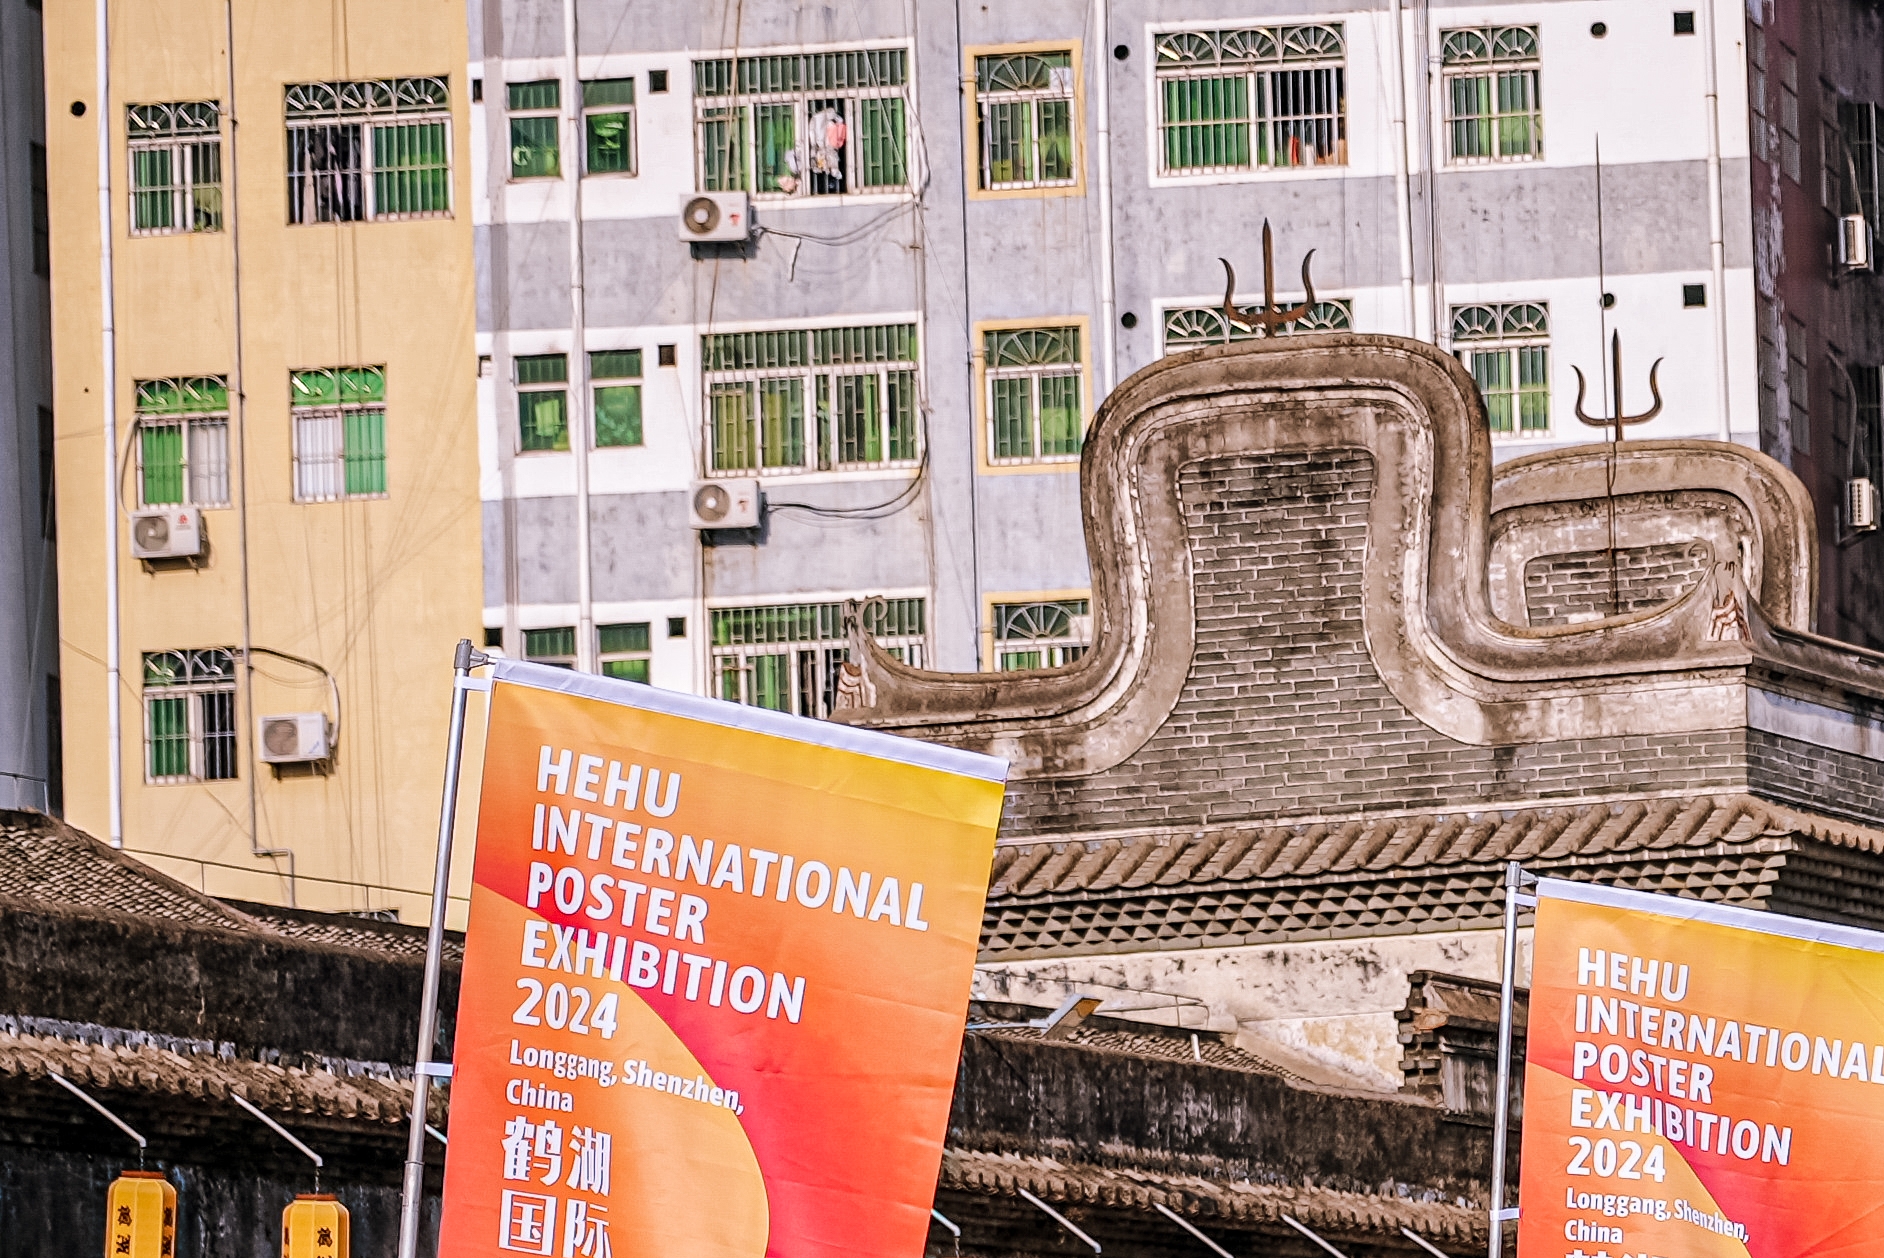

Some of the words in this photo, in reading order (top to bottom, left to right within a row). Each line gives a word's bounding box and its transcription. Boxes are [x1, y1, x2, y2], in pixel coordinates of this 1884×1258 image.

[537, 745, 681, 818] HEHU
[531, 804, 929, 932] INTERNATIONAL
[526, 862, 709, 943] POSTER
[521, 921, 806, 1023] EXHIBITION
[1577, 947, 1689, 1003] HEHU
[512, 978, 618, 1039] 2024
[505, 1079, 574, 1112] China
[509, 1039, 618, 1087] Longgang,
[622, 1059, 744, 1116] Shenzhen,
[1572, 1042, 1715, 1104] POSTER
[501, 1117, 611, 1196] 鹤湖
[1566, 1136, 1666, 1183] 2024
[1569, 1089, 1792, 1166] EXHIBITION
[1564, 1220, 1623, 1245] China
[1566, 1187, 1672, 1223] Longgang,
[1673, 1200, 1749, 1244] Shenzhen,
